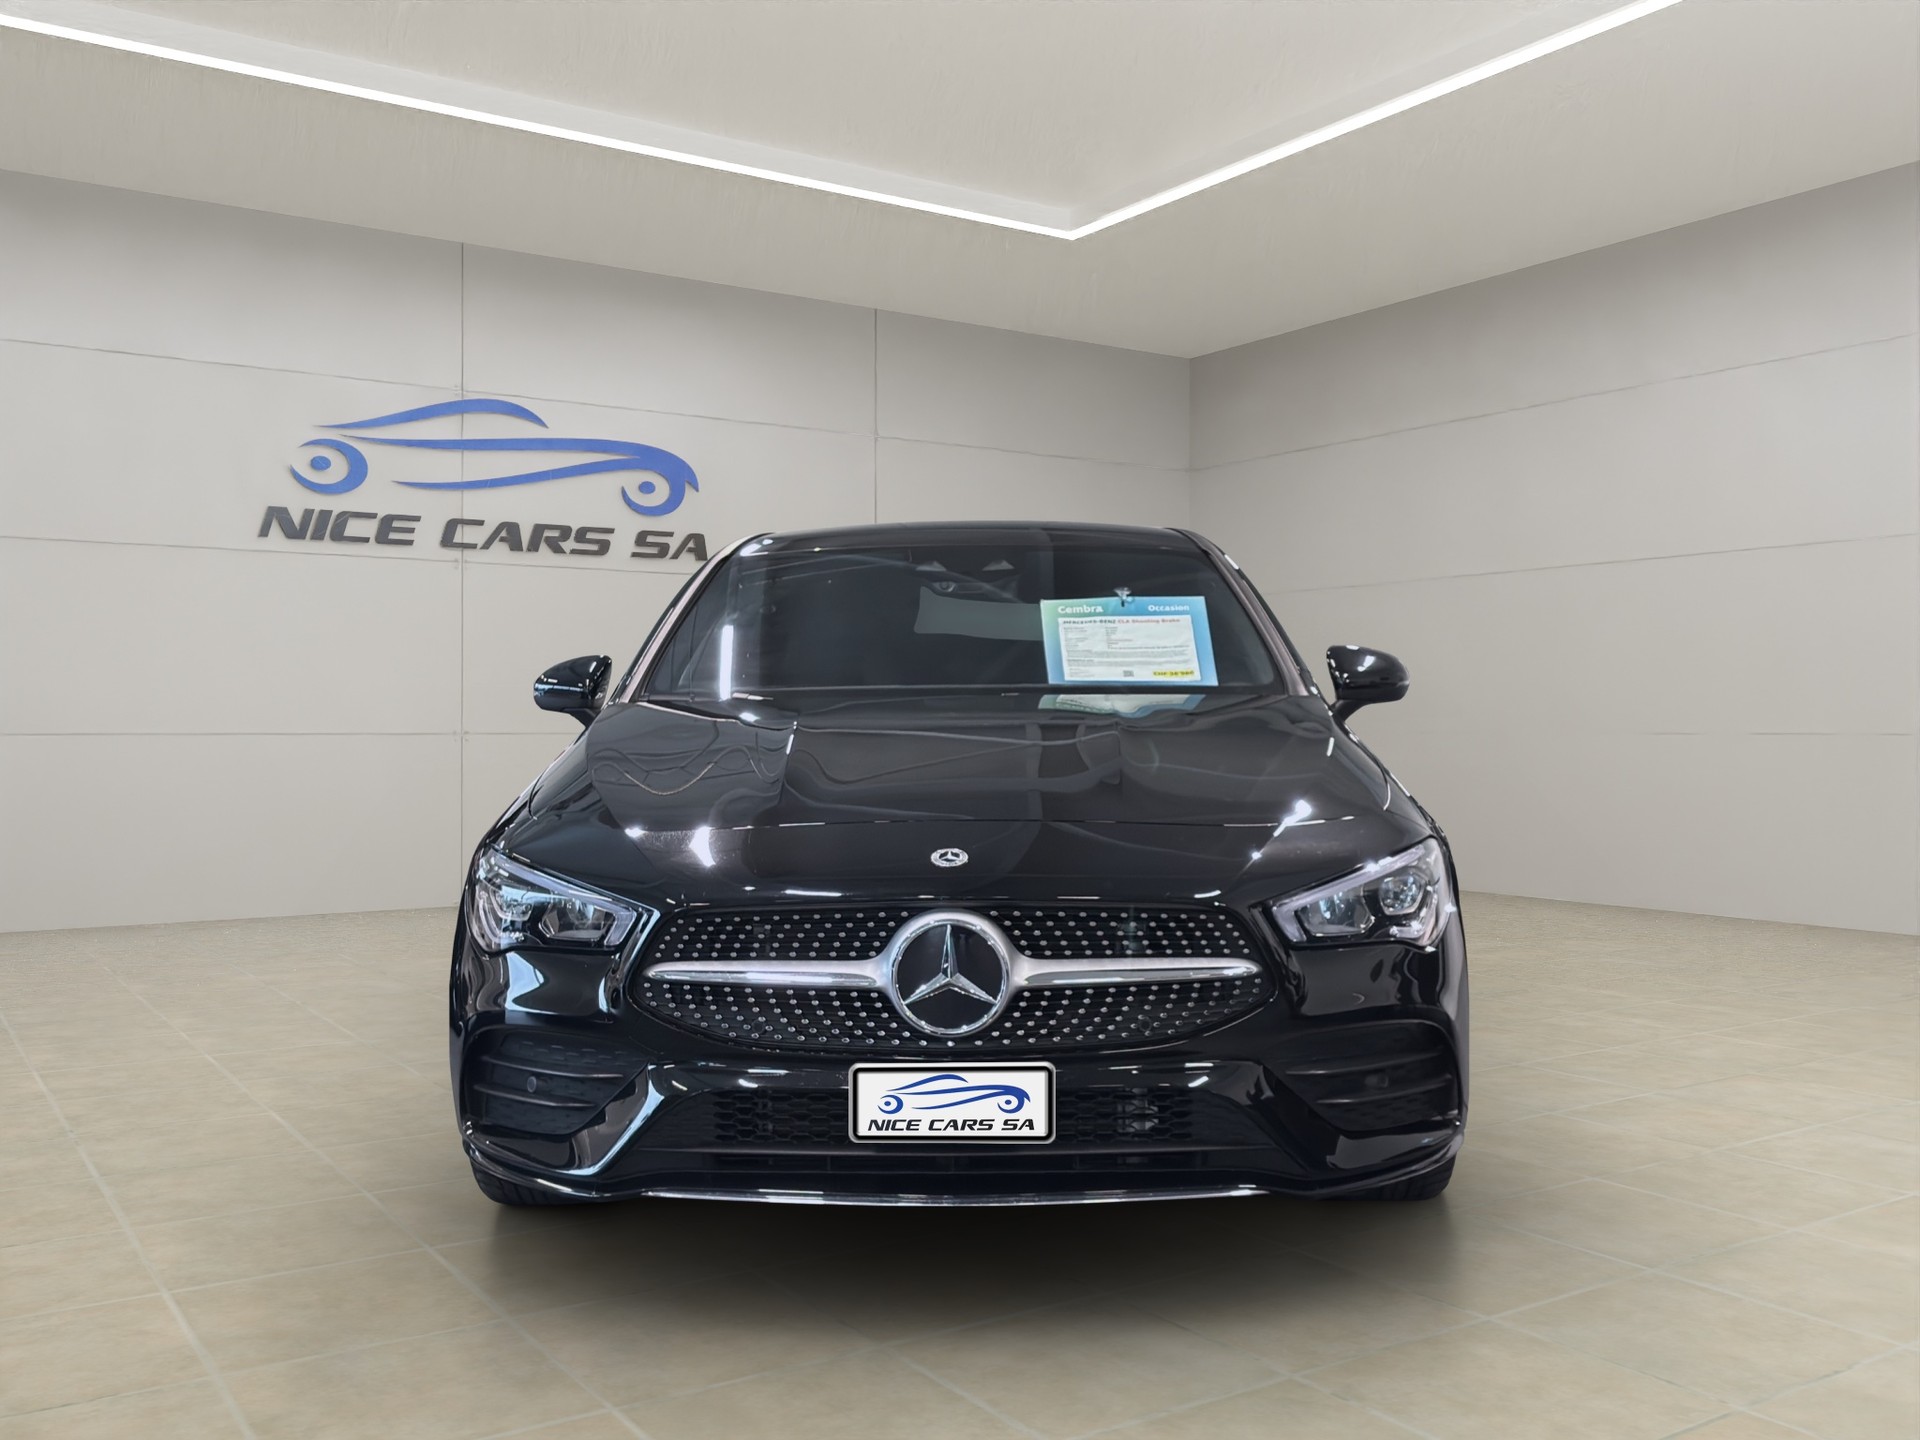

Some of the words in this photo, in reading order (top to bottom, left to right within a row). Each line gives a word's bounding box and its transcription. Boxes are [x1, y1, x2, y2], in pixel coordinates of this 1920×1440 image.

[258, 506, 421, 546] NICE
[440, 518, 615, 556] CARS
[630, 530, 708, 561] SA
[1057, 605, 1104, 614] Cembra
[1147, 604, 1190, 612] Occasion
[868, 1119, 922, 1131] NICE
[928, 1119, 995, 1131] CARS
[1001, 1119, 1035, 1131] SA
